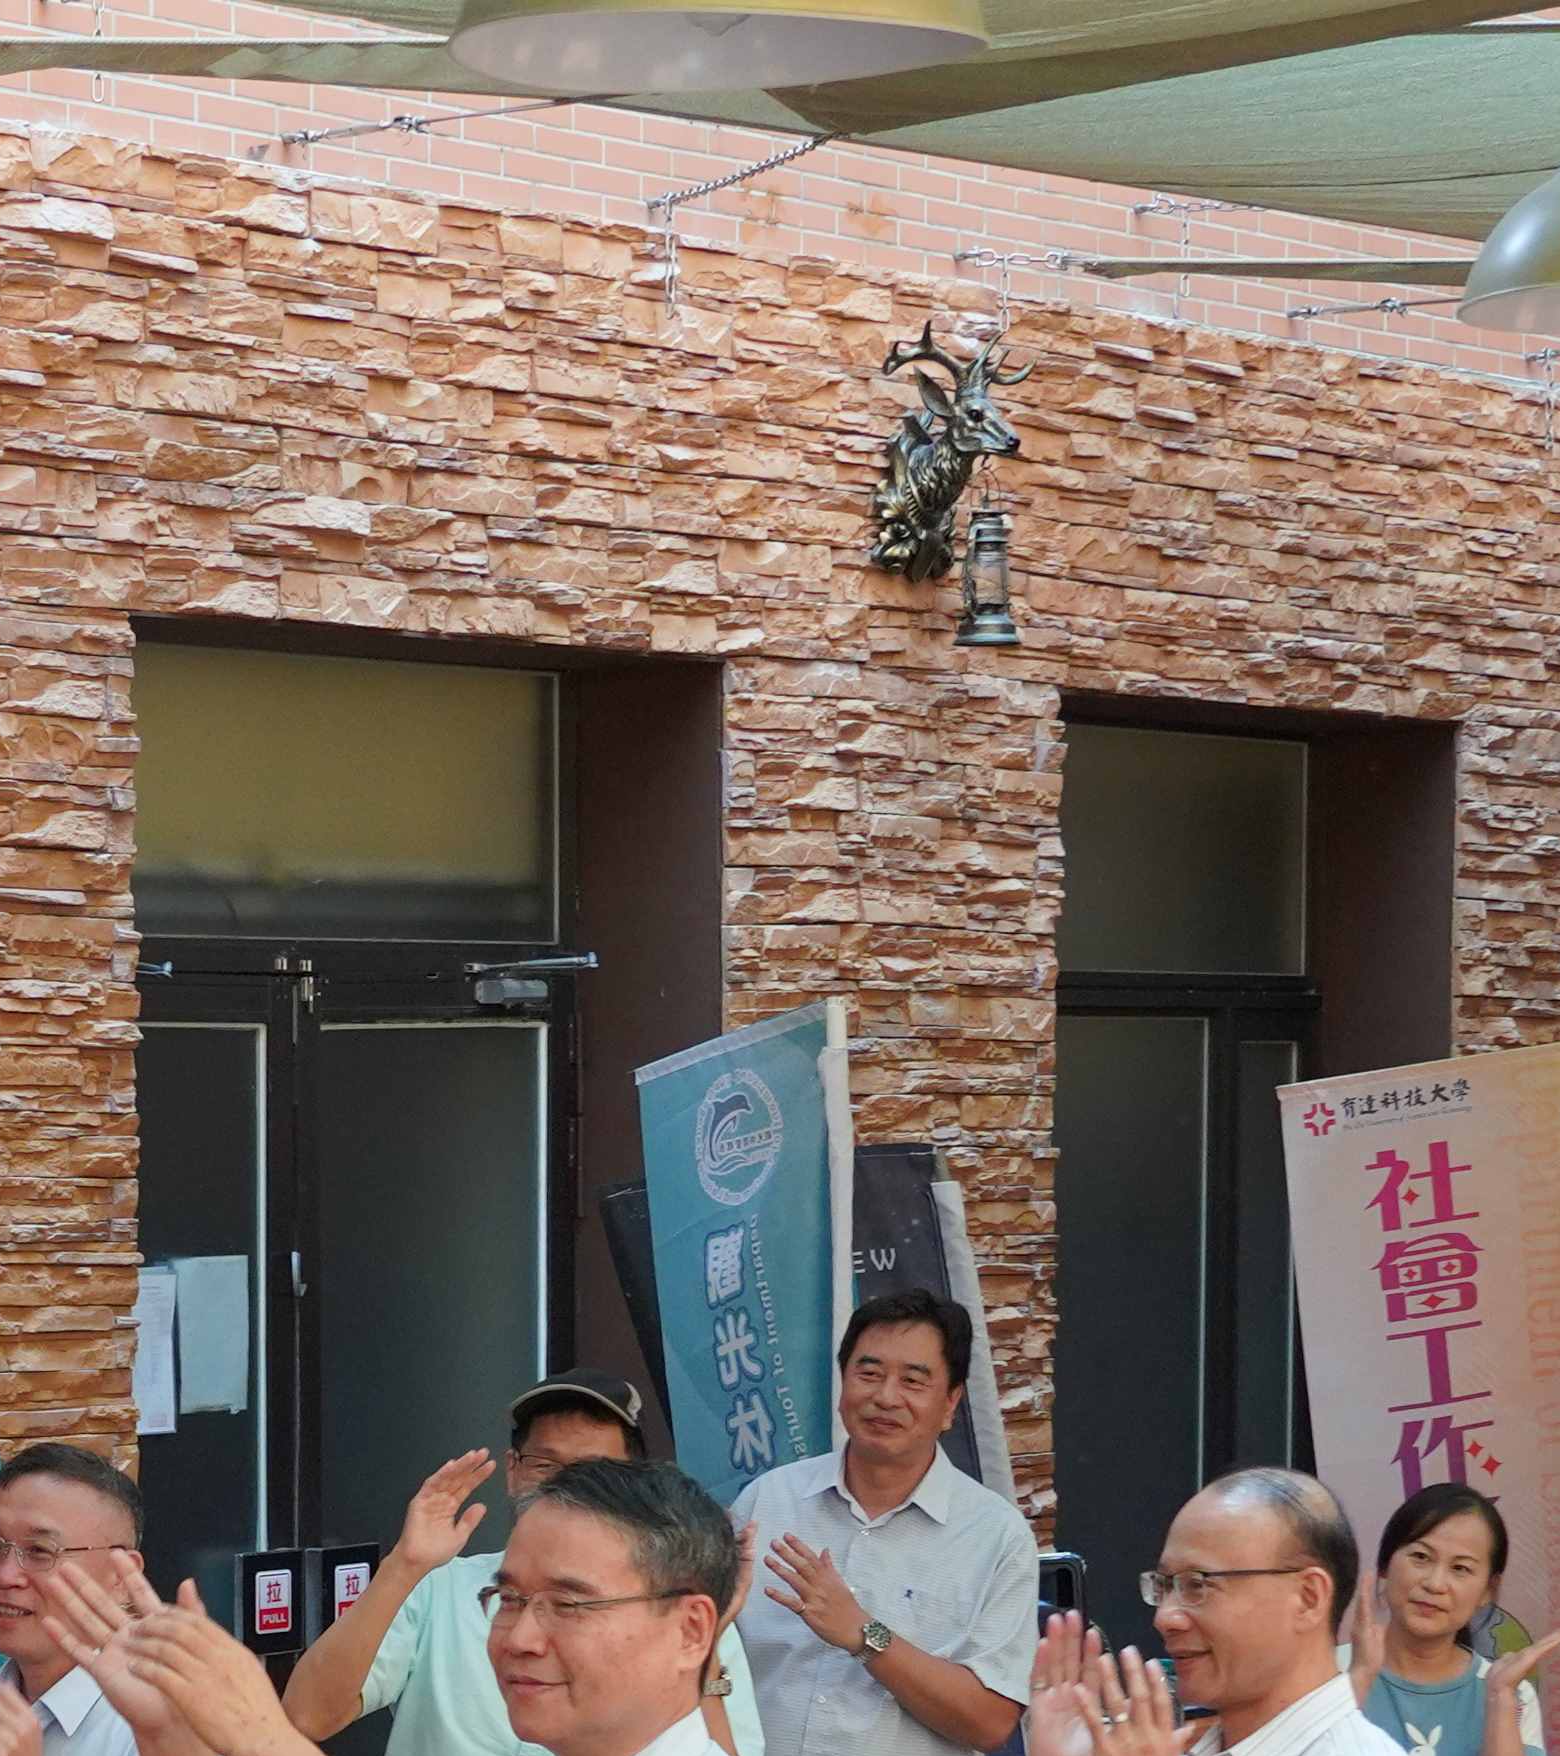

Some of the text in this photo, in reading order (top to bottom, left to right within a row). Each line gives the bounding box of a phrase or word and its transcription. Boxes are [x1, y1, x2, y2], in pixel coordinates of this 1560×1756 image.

[1341, 1078, 1472, 1121] 育達科技大學
[266, 1580, 282, 1603] 拉
[345, 1574, 360, 1596] 拉
[262, 1613, 287, 1625] PULL
